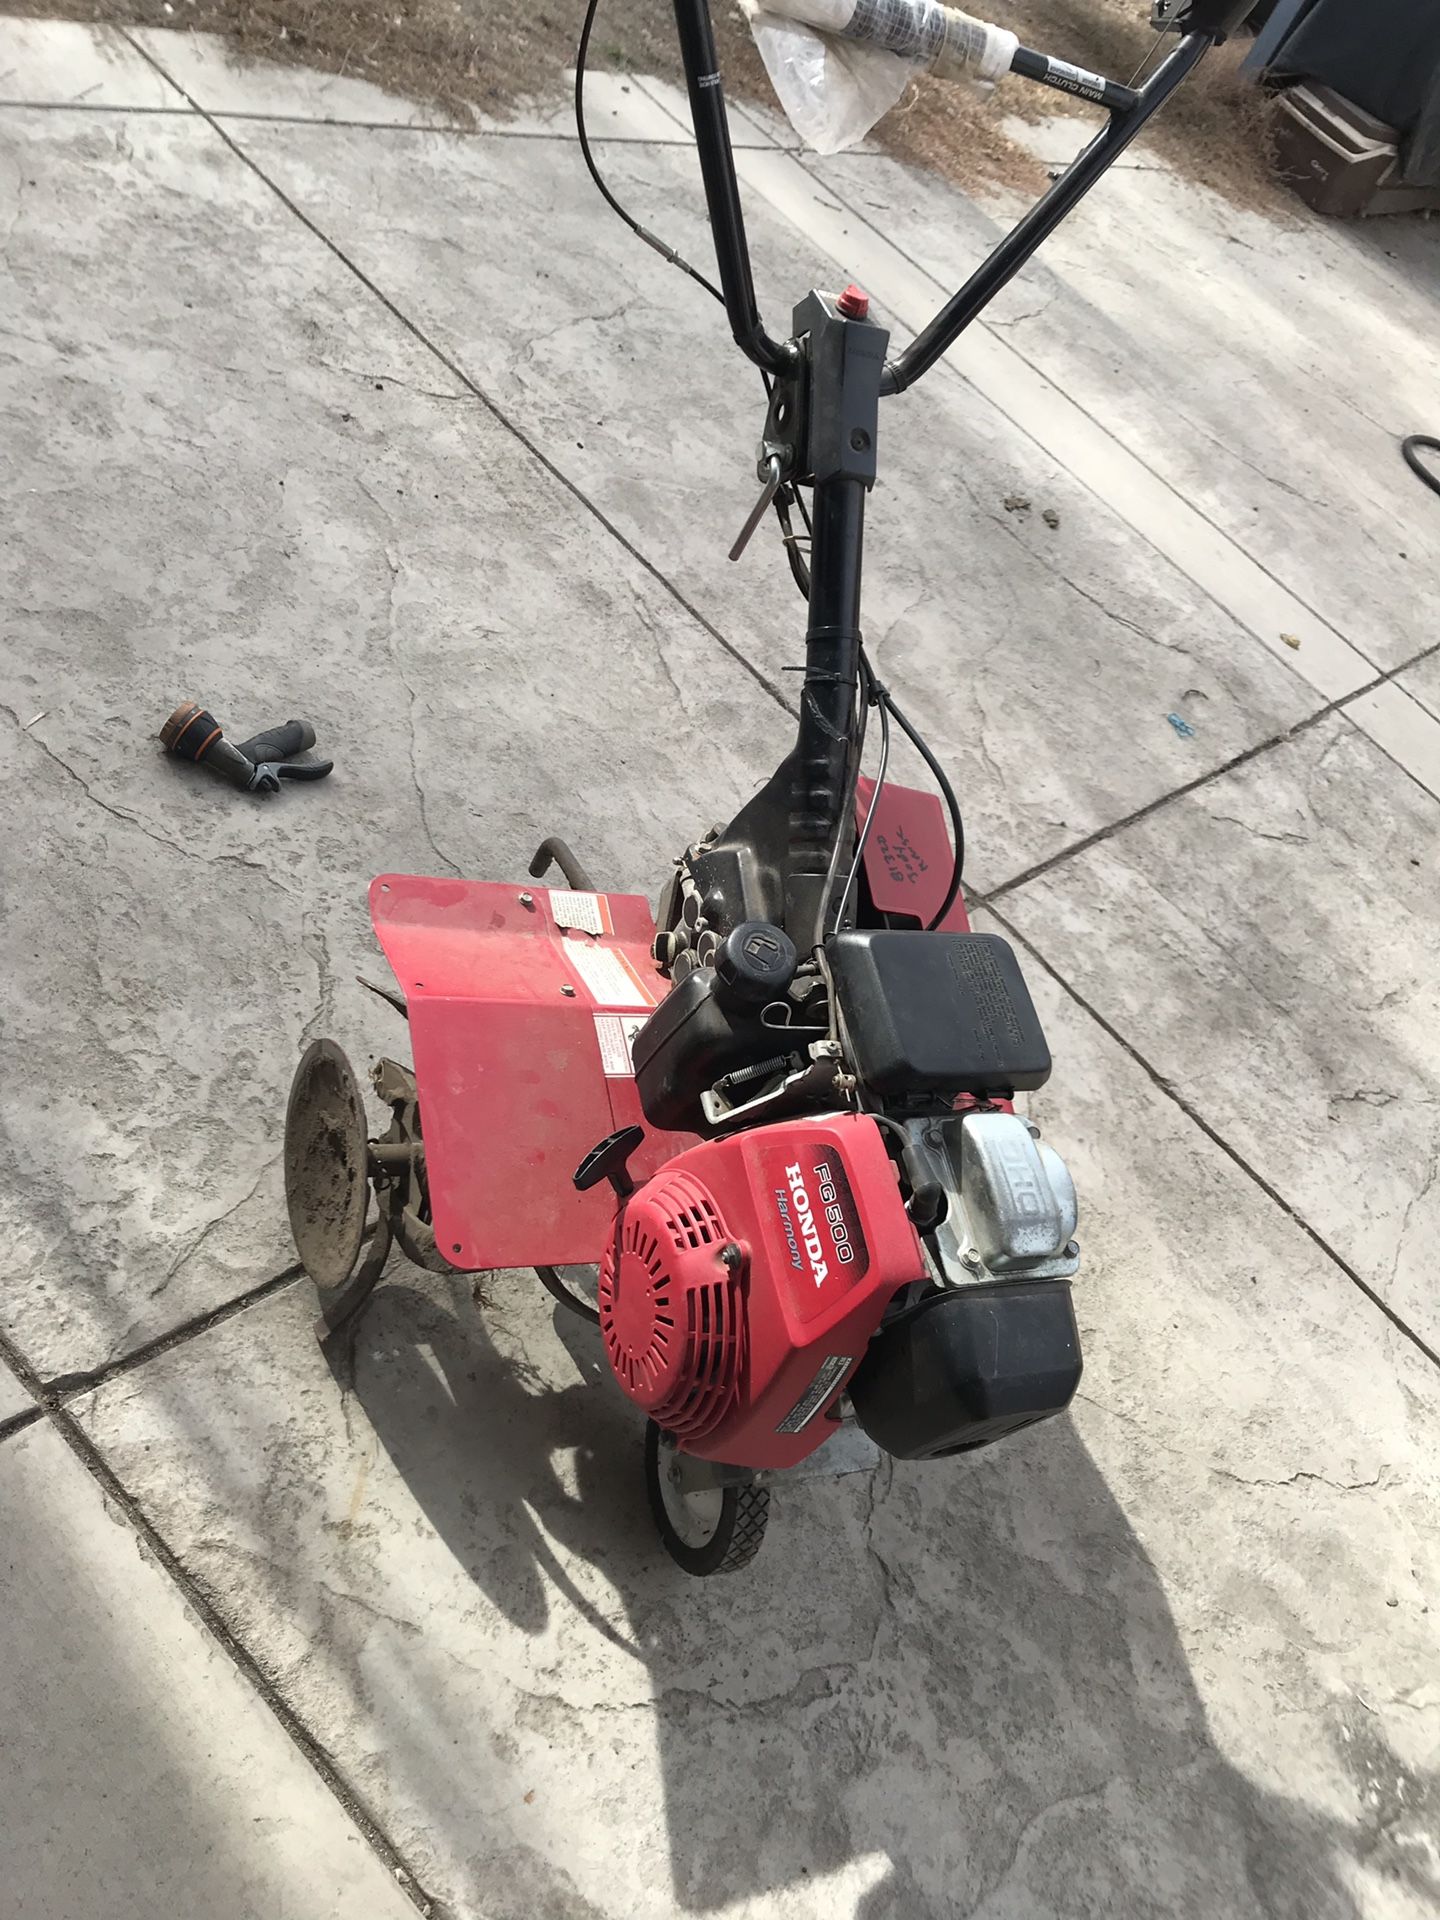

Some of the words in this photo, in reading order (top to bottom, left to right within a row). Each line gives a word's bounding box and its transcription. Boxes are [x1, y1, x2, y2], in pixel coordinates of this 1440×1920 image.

[1043, 73, 1079, 91] CLUTCH
[1079, 86, 1104, 100] MAIN
[774, 1189, 804, 1271] Harmony
[785, 1161, 829, 1289] HONDA
